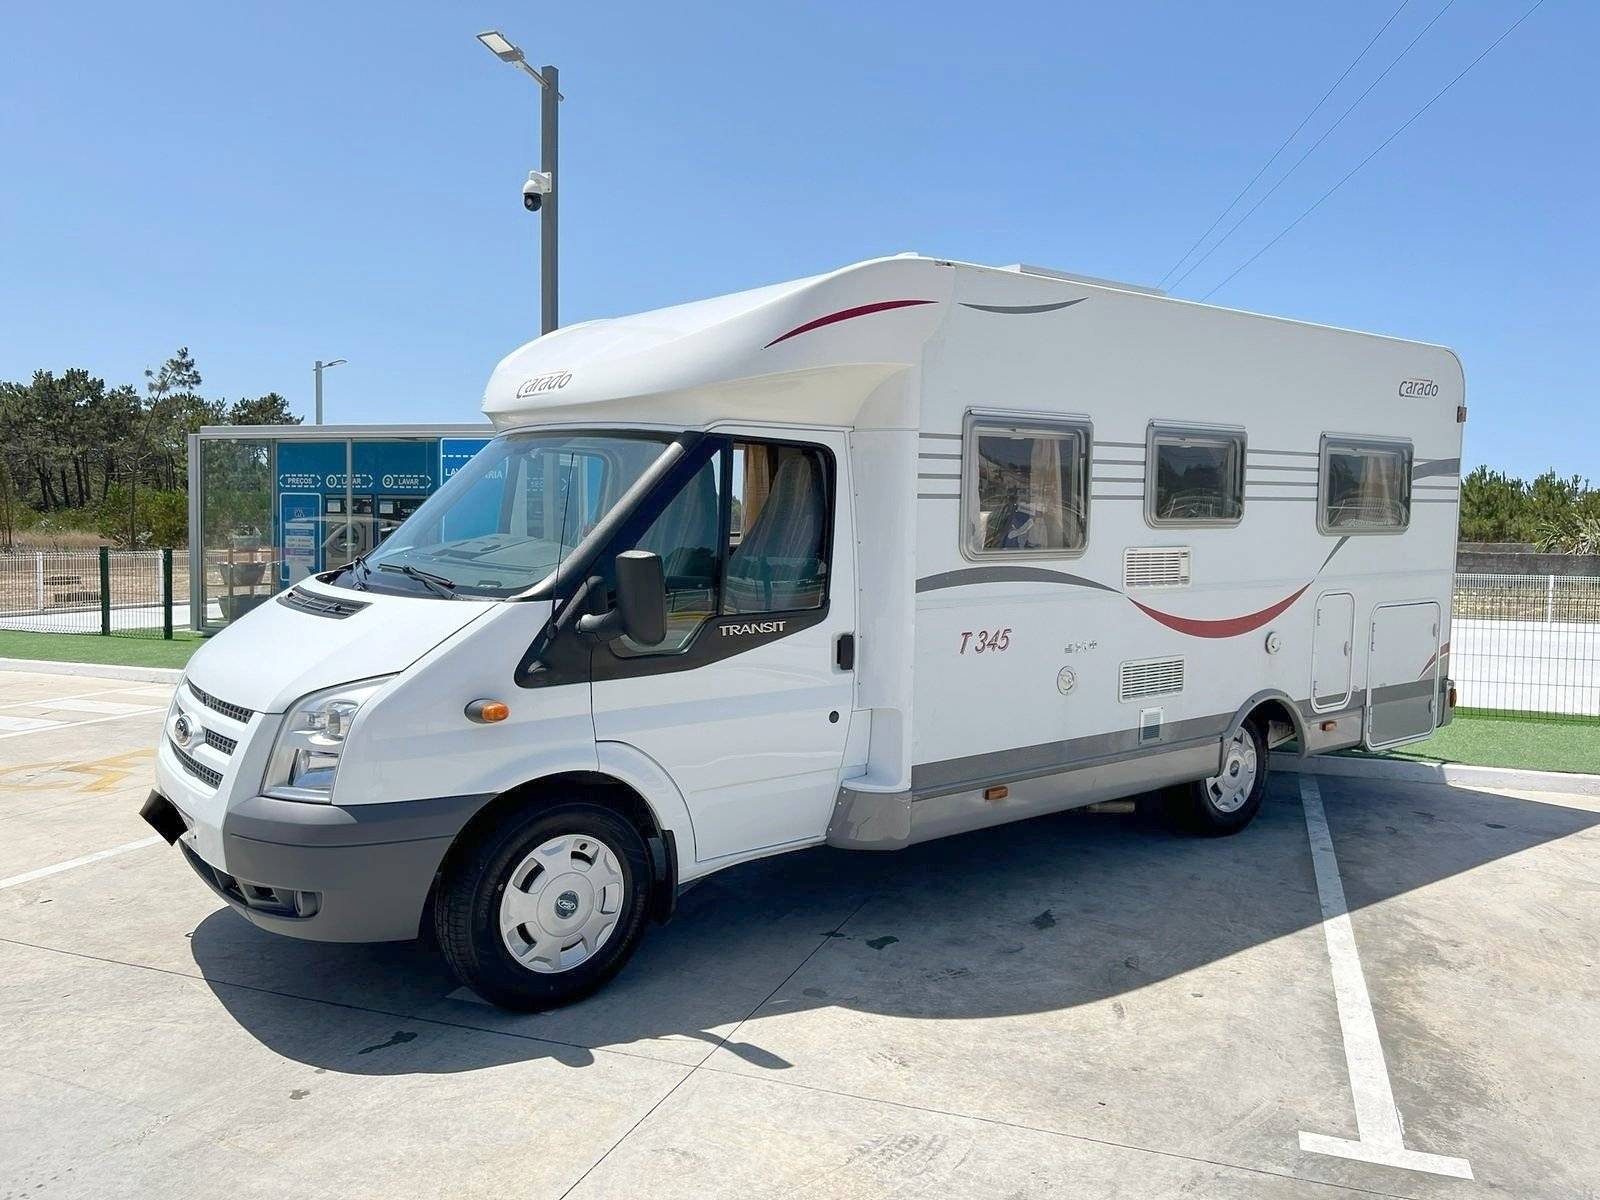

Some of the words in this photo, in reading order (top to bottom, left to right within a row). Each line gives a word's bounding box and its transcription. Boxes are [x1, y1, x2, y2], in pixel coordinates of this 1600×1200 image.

[287, 478, 313, 486] PREÇOS
[398, 478, 419, 486] LAVAR
[718, 620, 787, 637] TRANSIT
[959, 631, 973, 655] T
[974, 628, 1012, 654] 345
